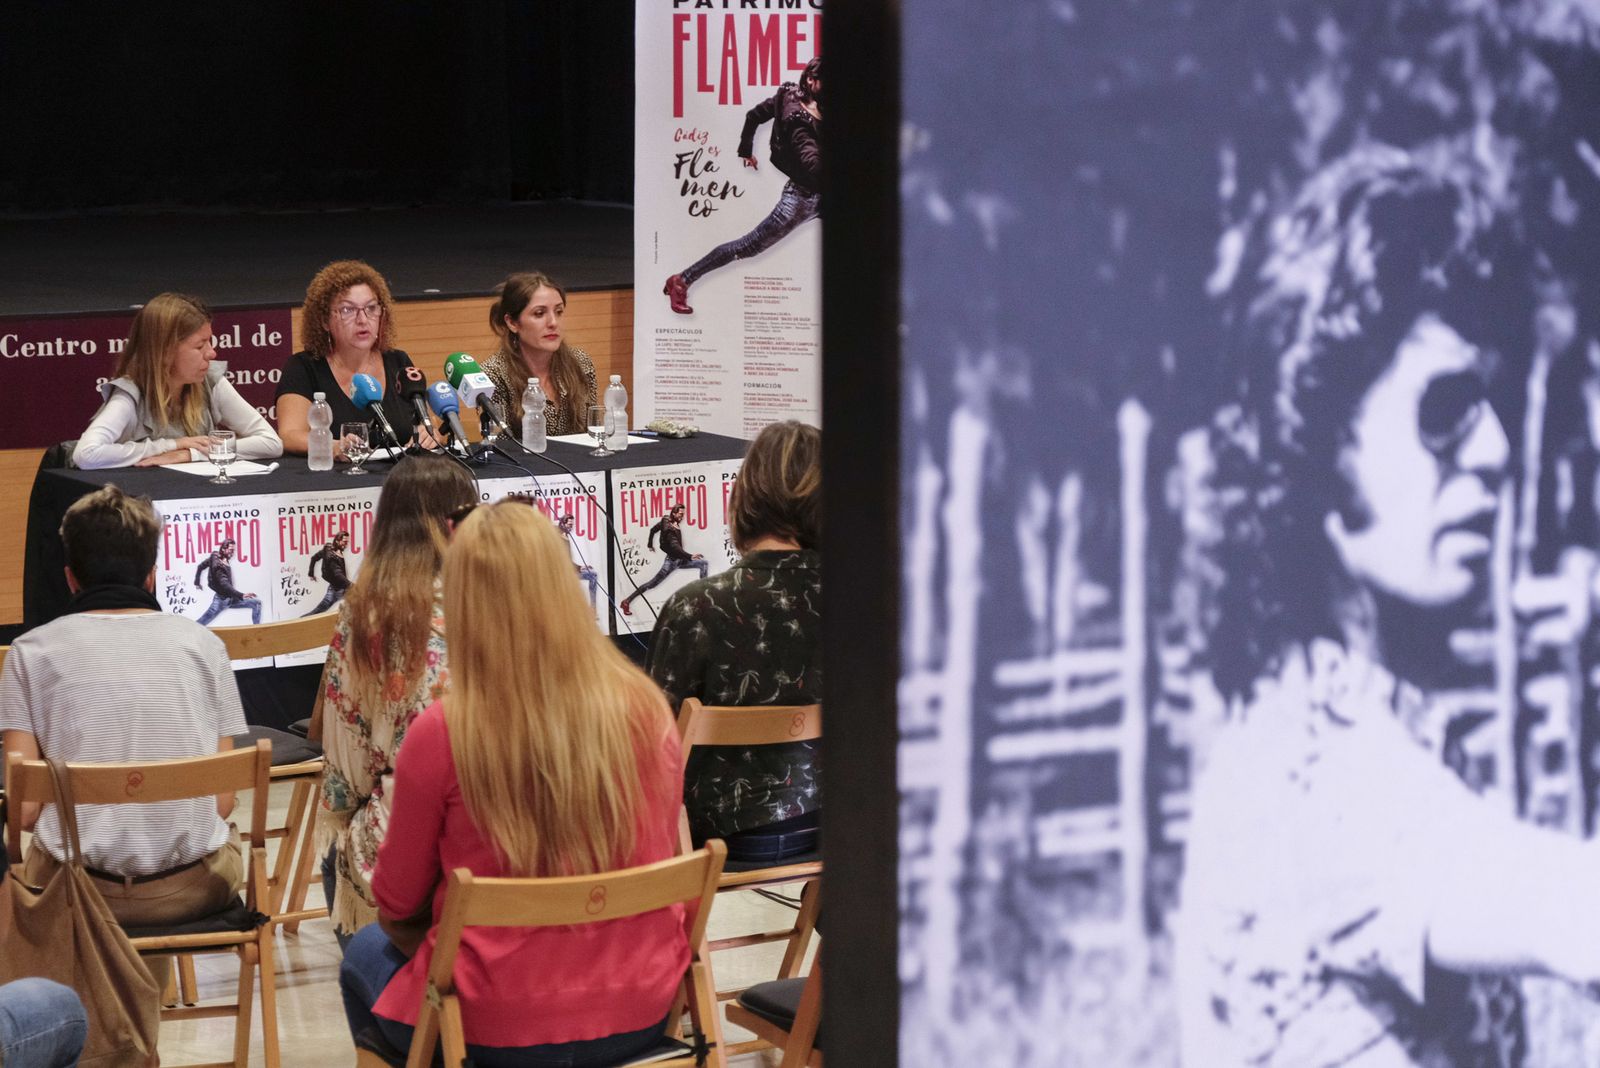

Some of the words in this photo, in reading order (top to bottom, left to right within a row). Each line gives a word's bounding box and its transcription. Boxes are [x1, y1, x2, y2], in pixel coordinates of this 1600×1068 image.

[673, 13, 823, 118] FLAME
[0, 333, 97, 358] Centro
[251, 323, 283, 347] de
[223, 368, 282, 385] enco
[620, 475, 706, 490] PATRIMONIO
[163, 508, 260, 522] PATRIMONIO
[278, 501, 373, 516] PATRIMONIO
[536, 494, 597, 541] MENCO
[620, 484, 708, 535] FLAMENCO
[164, 518, 261, 571] FLAMENCO
[278, 511, 373, 563] FLAMENCO
